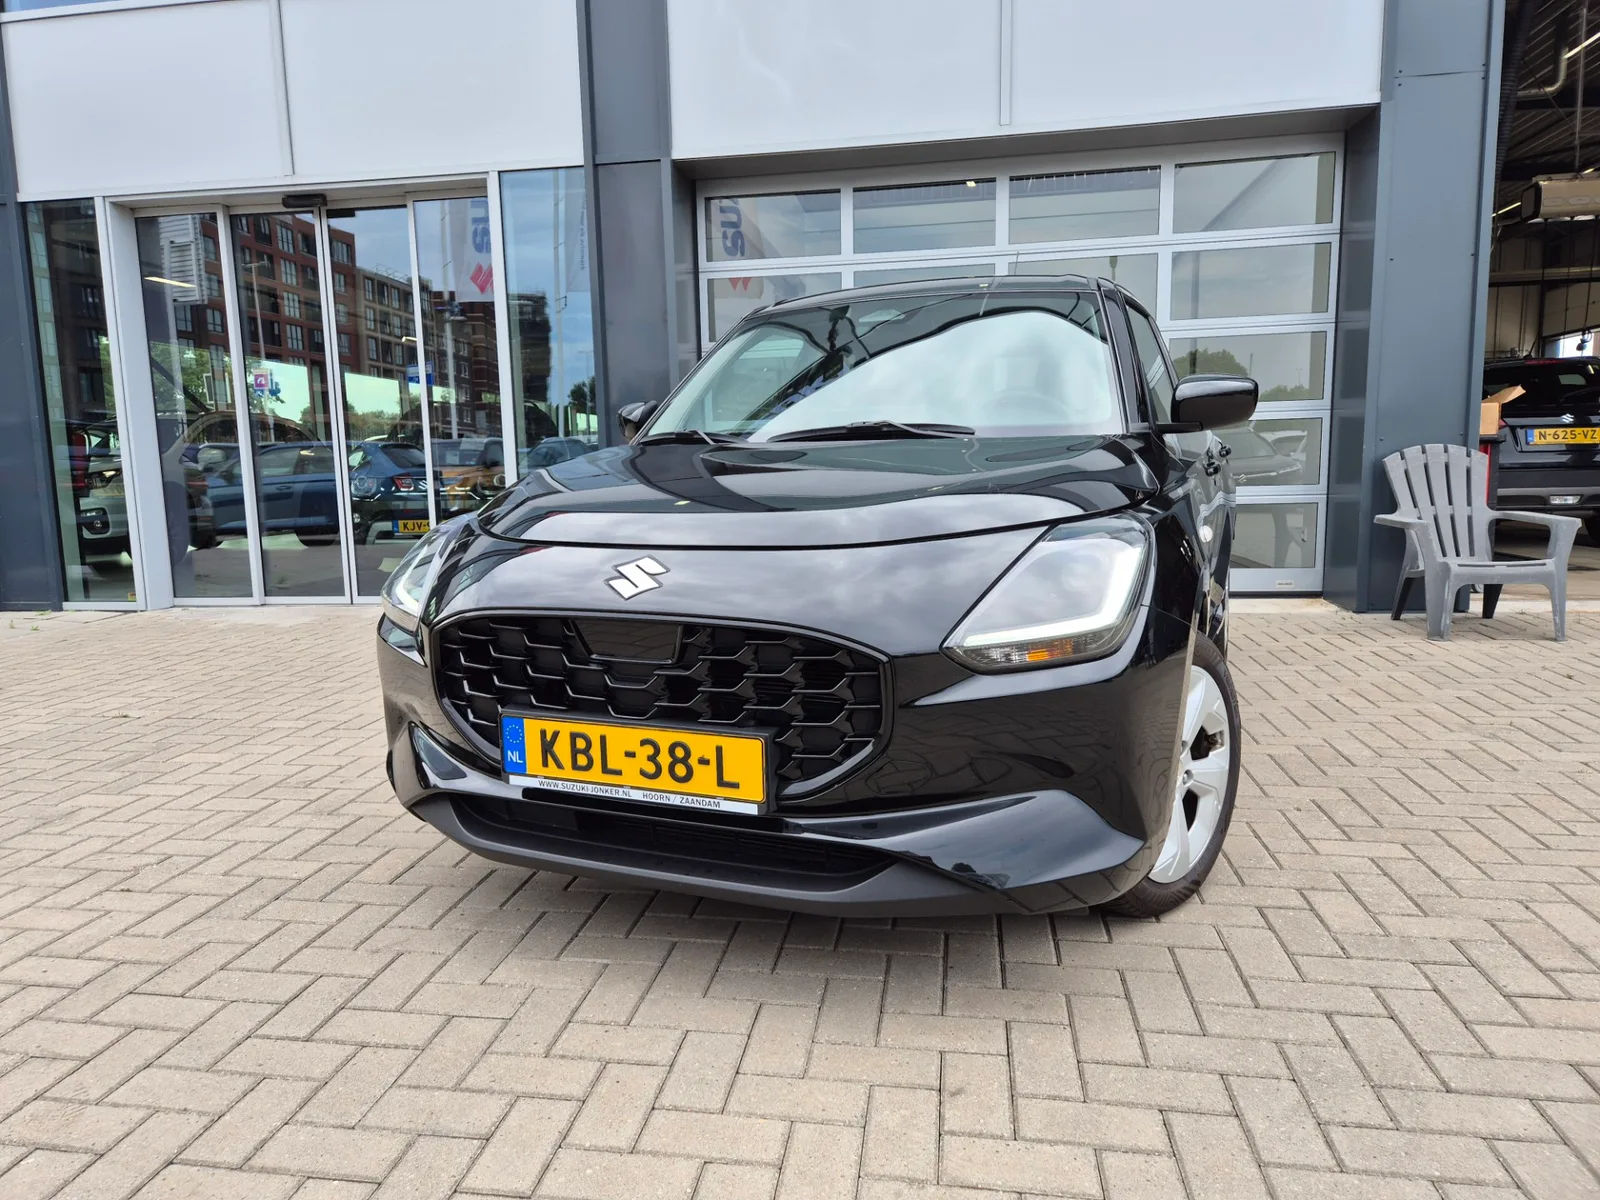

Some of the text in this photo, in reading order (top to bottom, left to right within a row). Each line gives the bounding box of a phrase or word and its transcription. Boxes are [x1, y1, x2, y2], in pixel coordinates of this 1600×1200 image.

[1538, 429, 1598, 441] N-625-VZ
[507, 750, 524, 763] NL
[539, 728, 740, 790] KBL-38-L
[642, 792, 671, 803] HOORN
[679, 796, 721, 809] ZAANDAM
